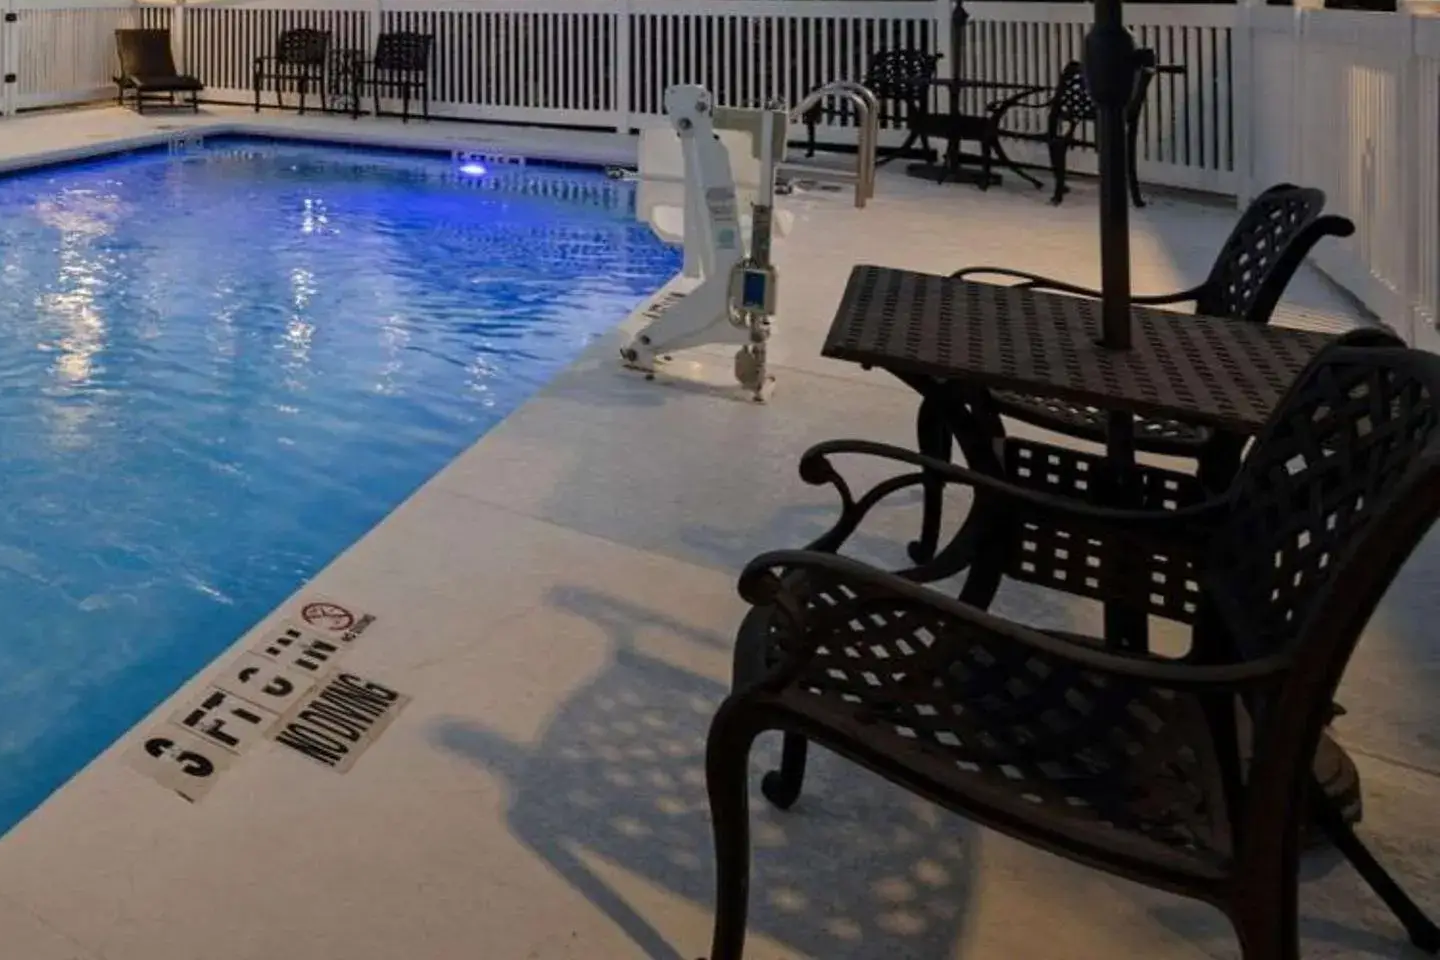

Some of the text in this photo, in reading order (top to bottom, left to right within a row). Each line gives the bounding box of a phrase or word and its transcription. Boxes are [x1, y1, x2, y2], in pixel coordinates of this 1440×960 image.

[144, 737, 214, 778] 3
[182, 691, 262, 747] FT
[298, 673, 400, 743] DIVING
[276, 723, 351, 767] NO
